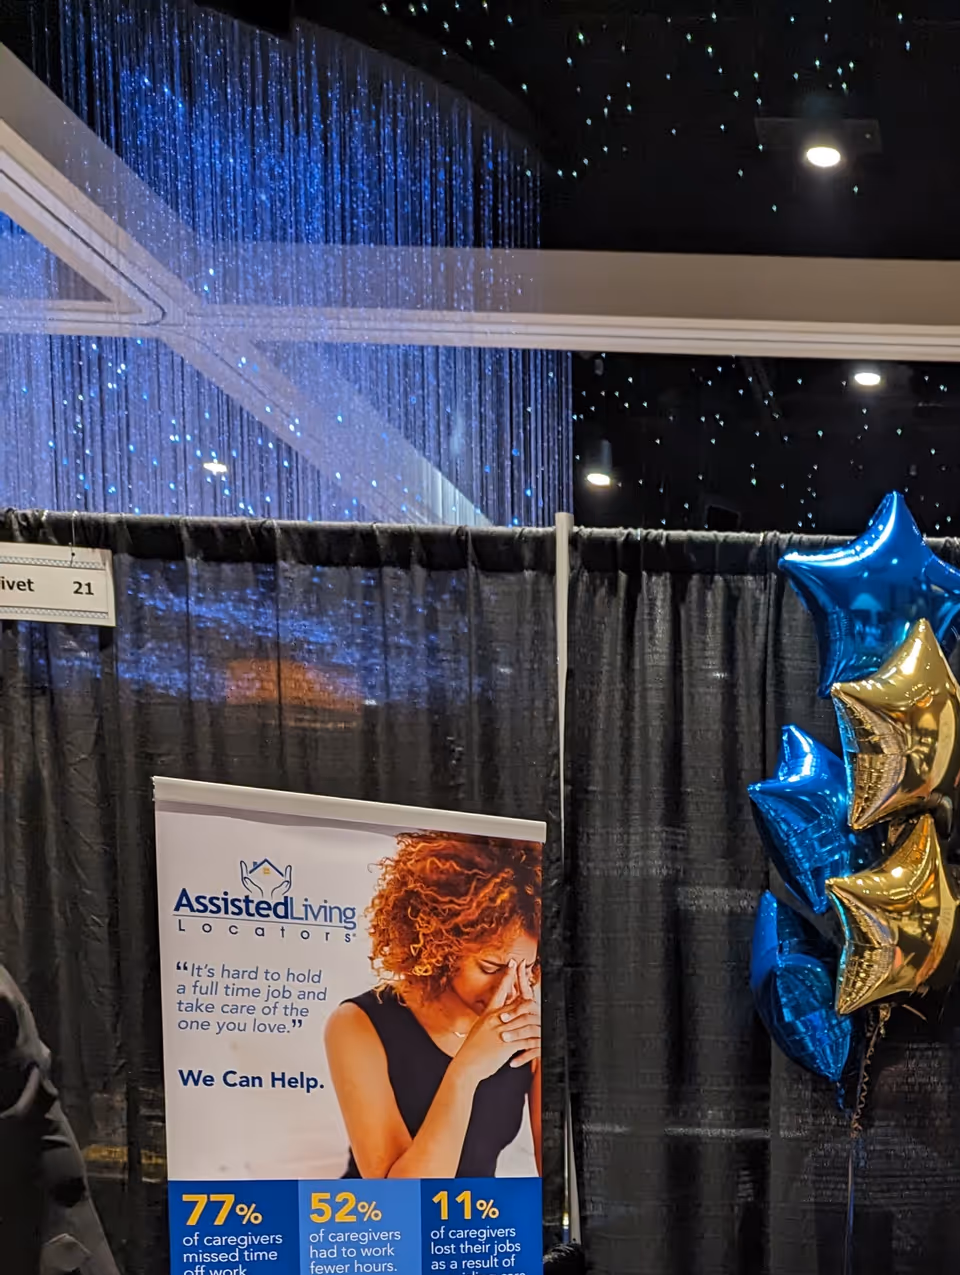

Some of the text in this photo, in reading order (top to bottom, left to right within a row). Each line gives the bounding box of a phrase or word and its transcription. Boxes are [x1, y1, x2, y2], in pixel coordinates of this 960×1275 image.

[0, 576, 35, 592] ivet
[73, 581, 94, 595] 21
[221, 965, 258, 981] hard
[286, 968, 322, 984] hold
[192, 981, 327, 1002] full time job and
[177, 1000, 309, 1017] take care the
[178, 1019, 211, 1031] one
[216, 1021, 247, 1035] you
[179, 1070, 325, 1093] We Can Help.
[182, 1194, 263, 1225] 77%
[309, 1192, 382, 1223] 52%
[431, 1190, 499, 1221] 11%
[204, 1232, 283, 1250] caregivers
[328, 1228, 401, 1245] caregivers
[449, 1226, 516, 1243] caregivers
[183, 1248, 278, 1264] missed time
[309, 1244, 395, 1258] had work
[431, 1240, 521, 1257] lost their jobs
[309, 1259, 397, 1275] fewer hours.
[462, 1256, 498, 1269] result
